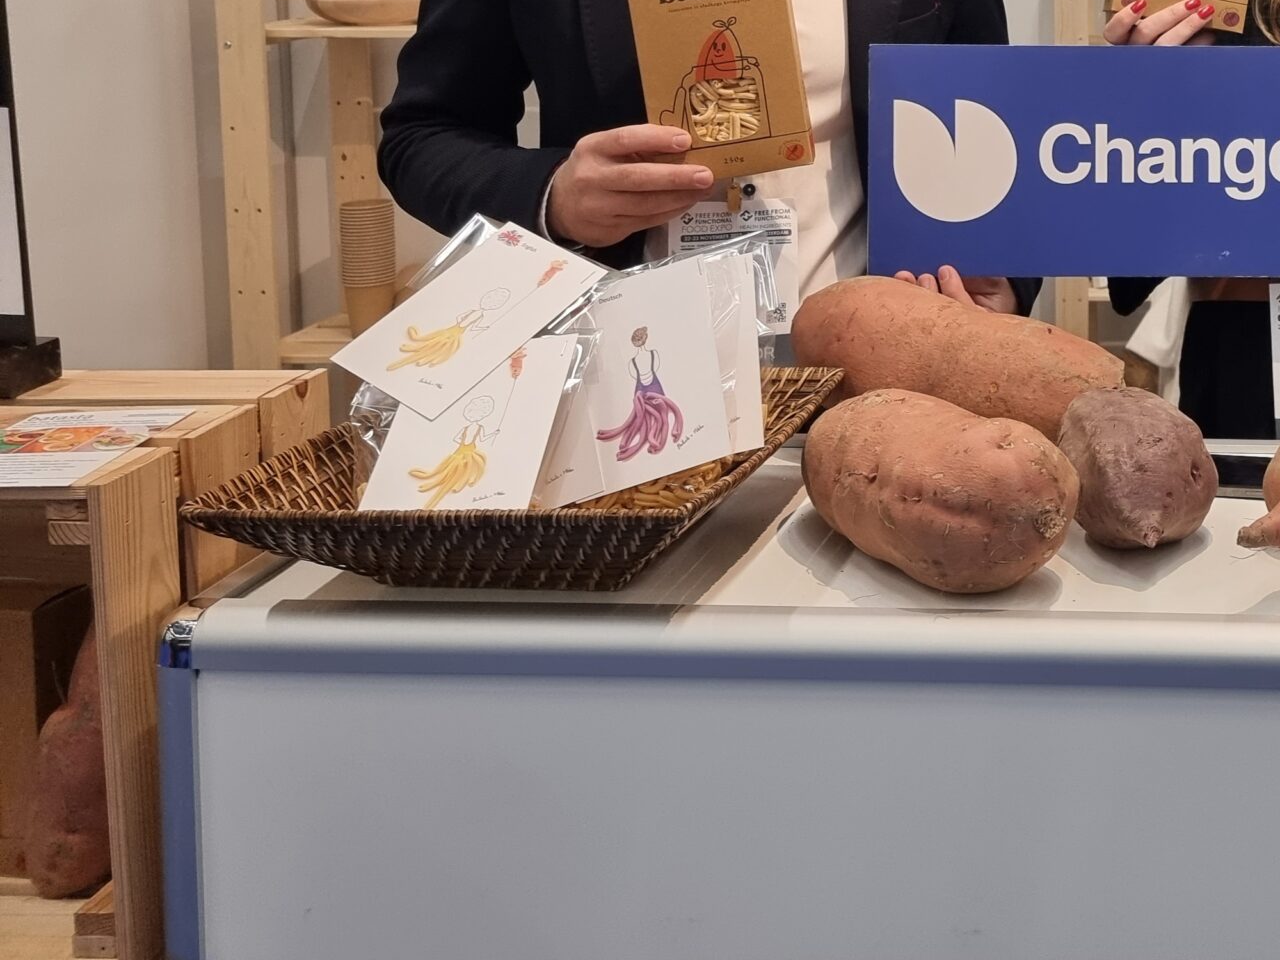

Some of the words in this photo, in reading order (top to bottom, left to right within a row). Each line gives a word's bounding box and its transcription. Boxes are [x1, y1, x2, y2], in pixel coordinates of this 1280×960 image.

[681, 225, 708, 233] FOOD
[710, 224, 733, 232] EXPO
[598, 293, 623, 304] Deutsch
